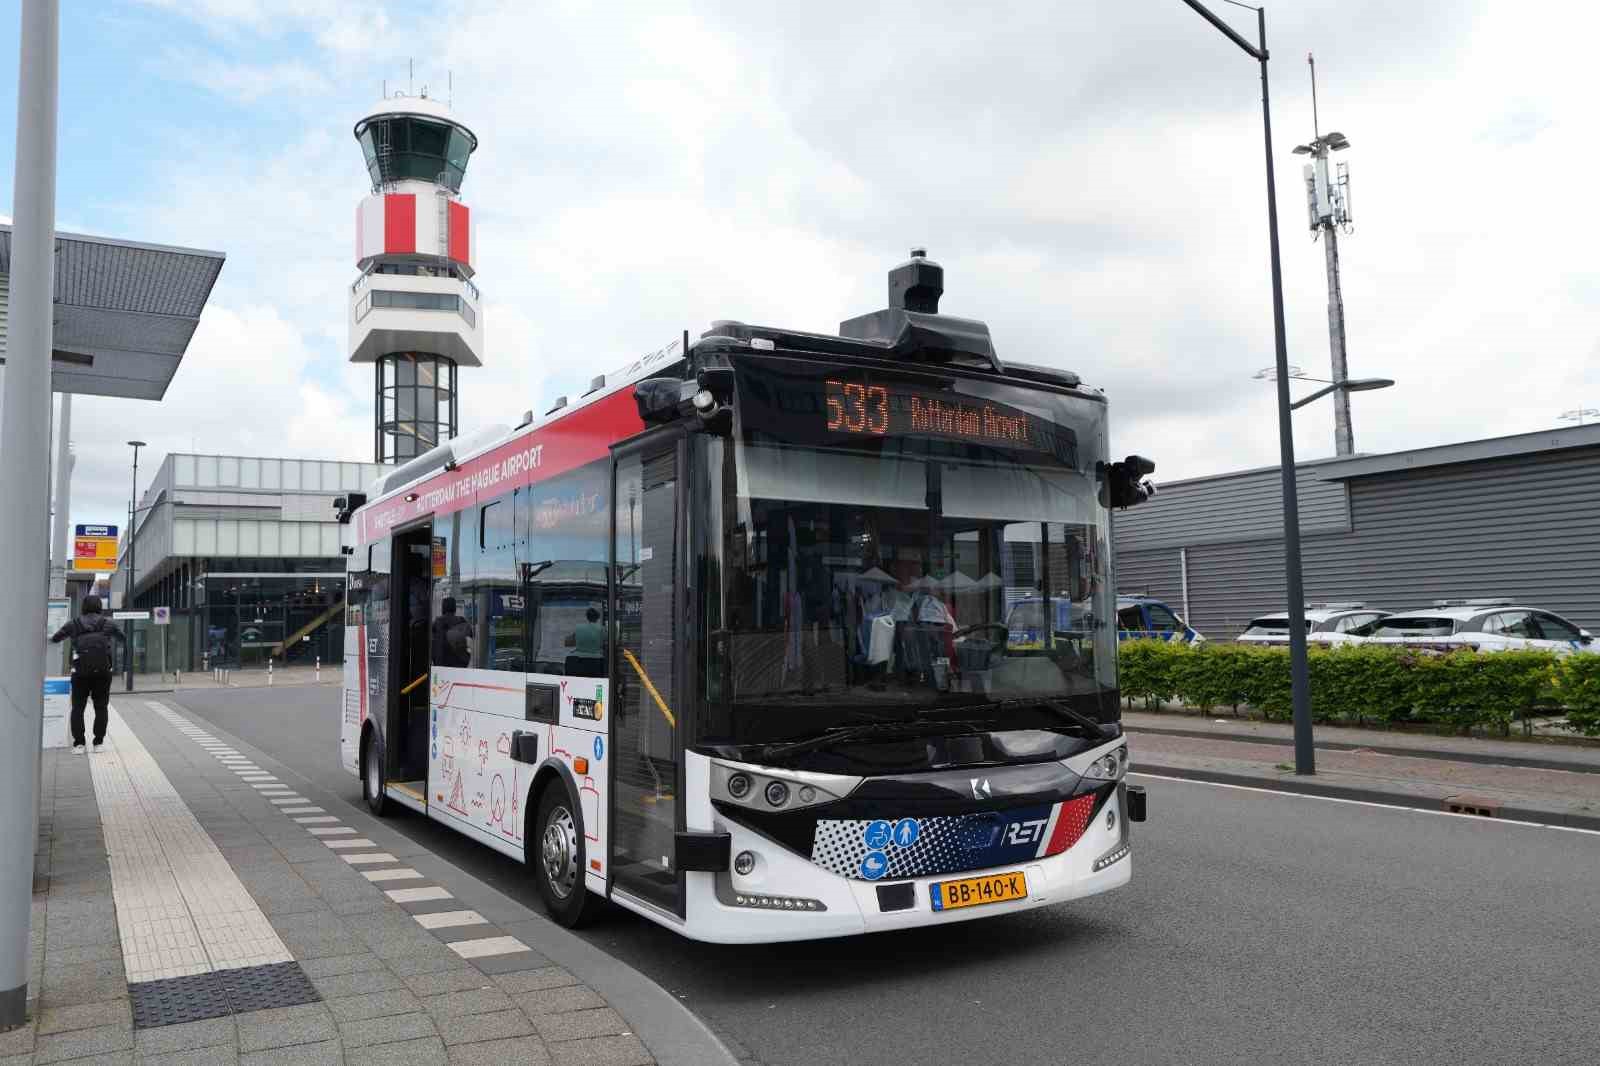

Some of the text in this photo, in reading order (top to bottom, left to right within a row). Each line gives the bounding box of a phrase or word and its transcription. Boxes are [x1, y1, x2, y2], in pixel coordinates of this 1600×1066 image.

[825, 378, 1029, 441] 533 Rotterdam Airport
[416, 444, 543, 512] ROTTERDAM THE HAGUE AIRPORT
[1008, 818, 1048, 845] RET
[948, 877, 1020, 904] BB-140-K
